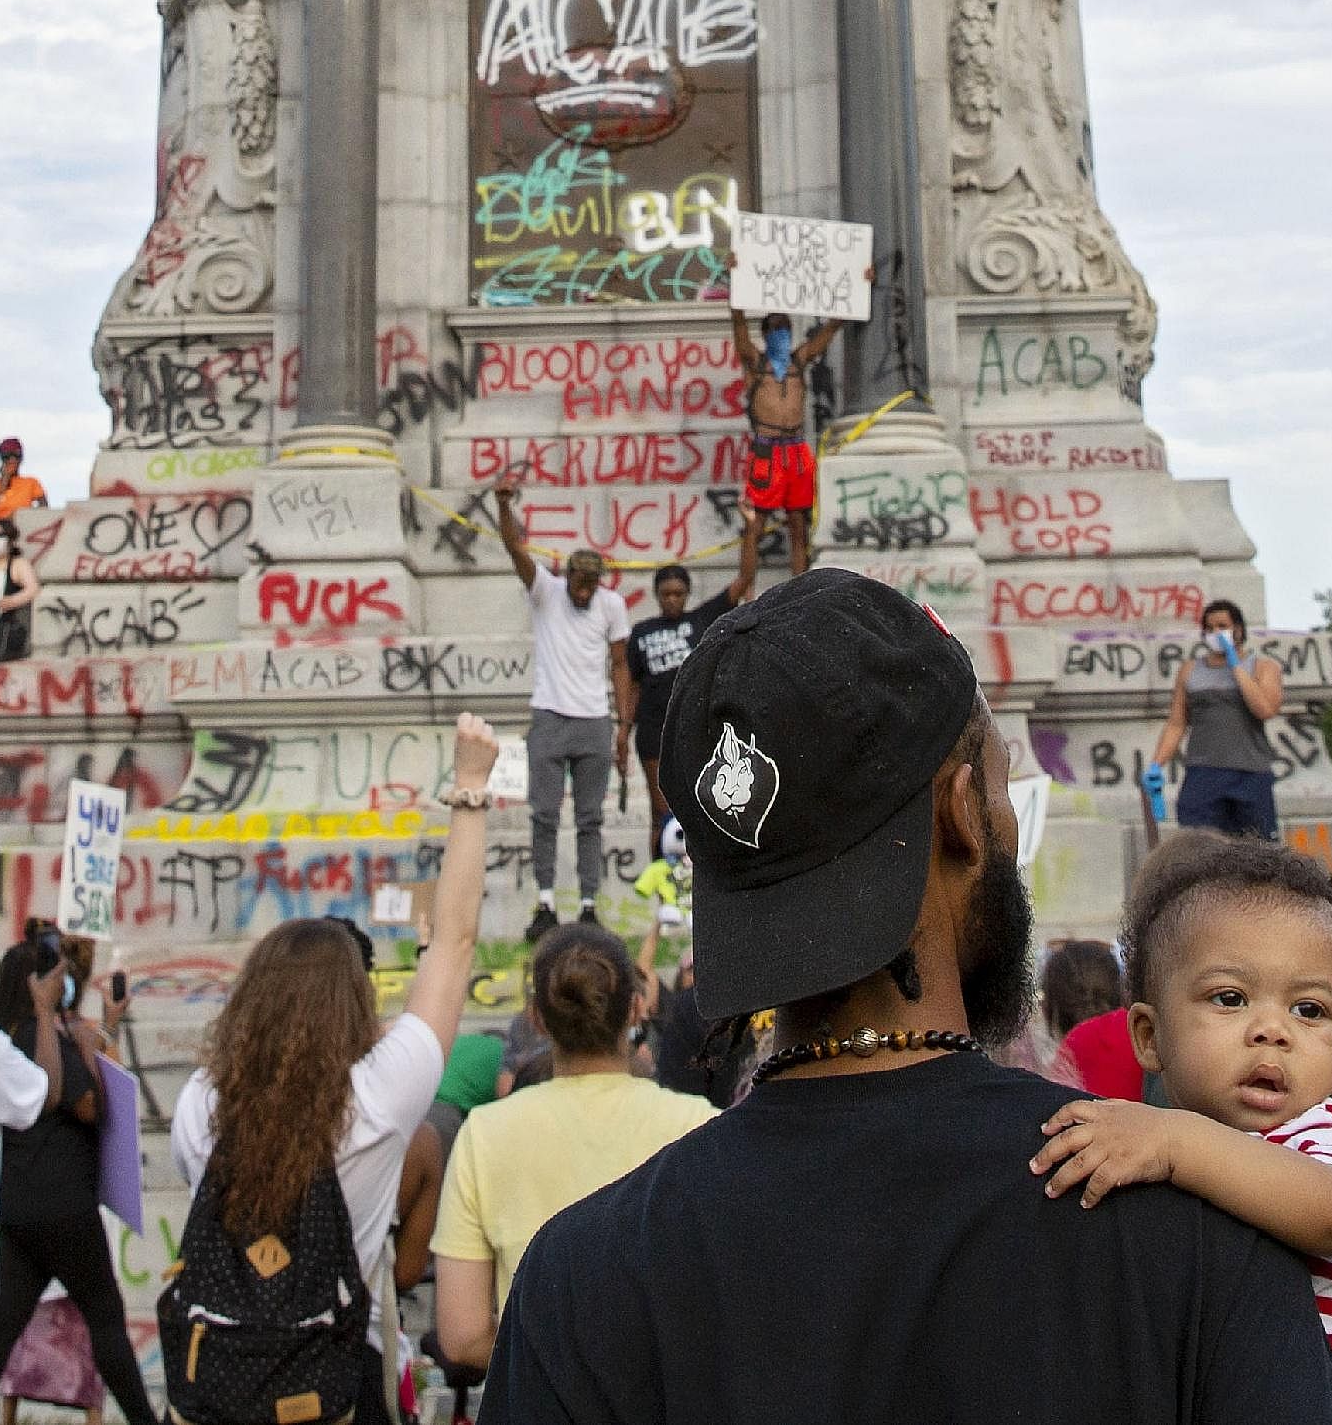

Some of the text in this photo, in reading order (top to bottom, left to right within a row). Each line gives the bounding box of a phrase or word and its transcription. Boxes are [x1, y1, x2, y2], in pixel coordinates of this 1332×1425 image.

[833, 226, 862, 251] OF
[479, 340, 601, 397] BLOOD
[974, 327, 1108, 405] ACAB
[566, 378, 746, 420] HANDS
[471, 436, 593, 487] BLACK
[85, 503, 192, 556] ONE
[522, 493, 700, 560] FUCK
[969, 486, 1103, 535] HOLD
[1010, 525, 1113, 558] COPS
[260, 649, 364, 694] ACAB
[1064, 642, 1146, 679] END
